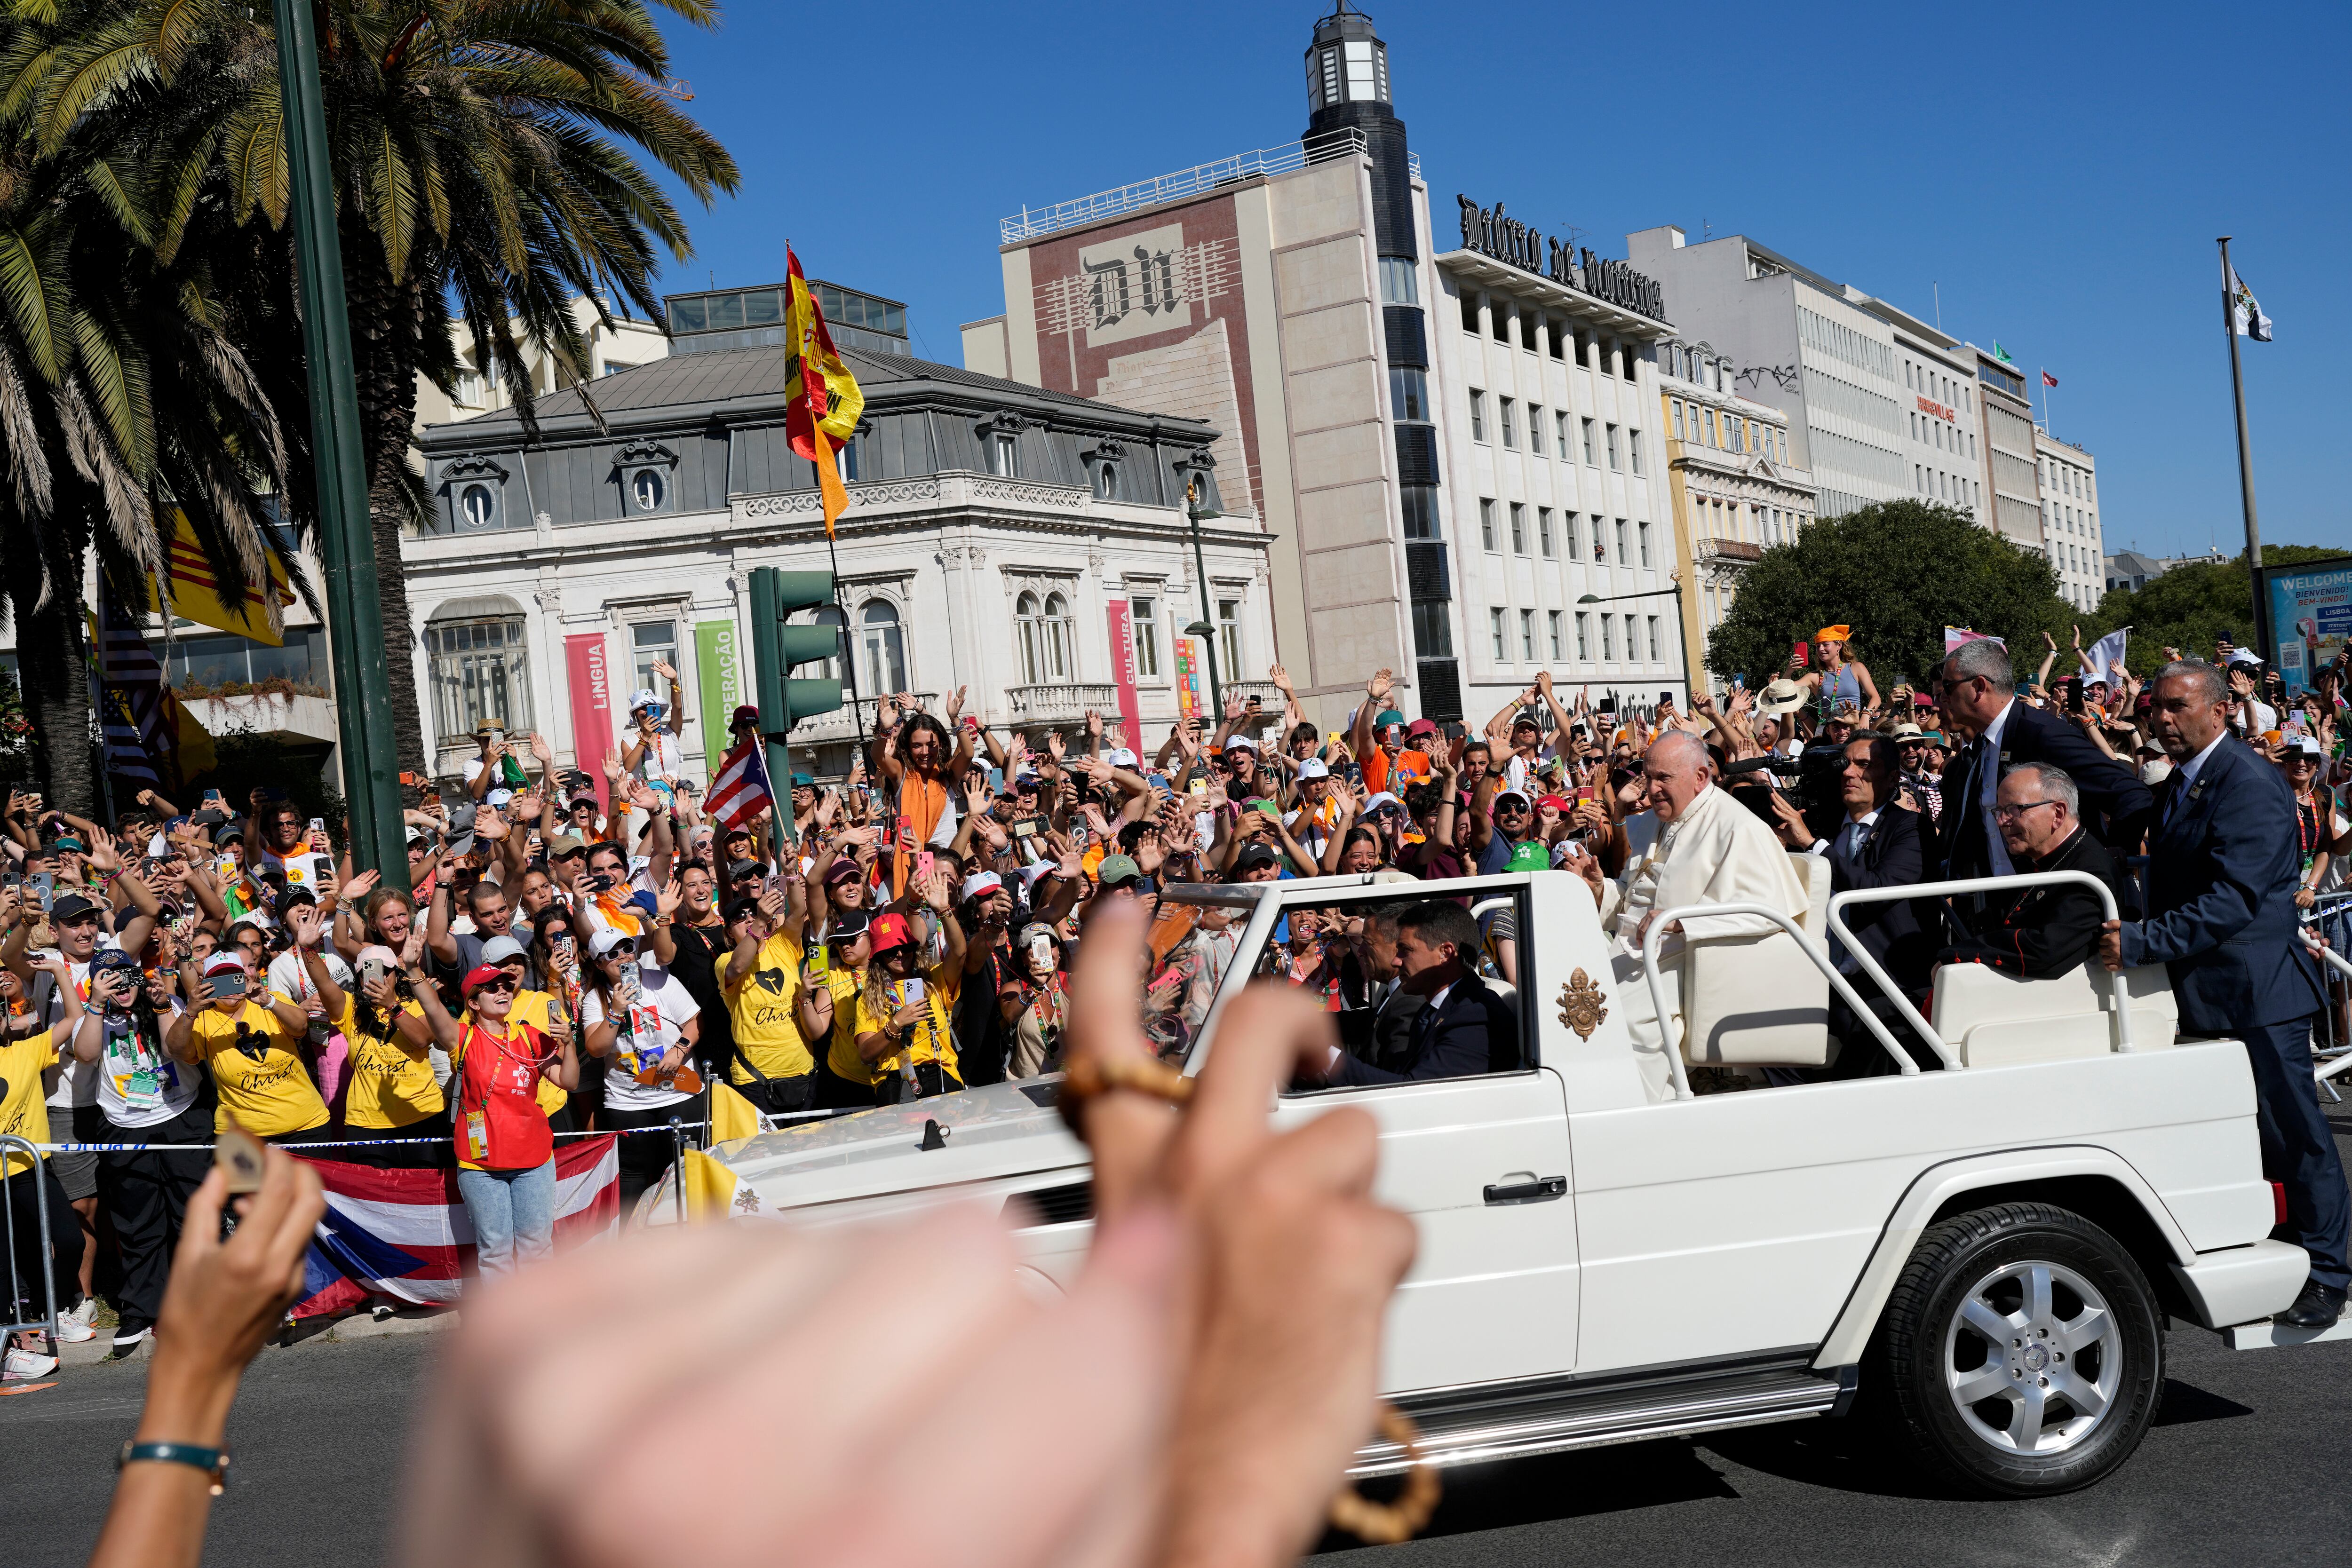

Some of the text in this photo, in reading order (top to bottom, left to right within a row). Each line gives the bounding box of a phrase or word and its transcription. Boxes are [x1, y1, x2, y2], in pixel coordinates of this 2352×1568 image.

[2281, 571, 2352, 591] WELCOME
[2296, 586, 2349, 598] BIENVENIDO!
[2298, 594, 2348, 606] BEM-VINDO!
[1121, 611, 1134, 685] CULTURA
[588, 643, 607, 709] LÍNGUA
[95, 951, 124, 966] LISBOA
[755, 1004, 799, 1025] Chris
[259, 1061, 287, 1074] THROUGH
[357, 1053, 411, 1073] Christ
[241, 1059, 295, 1091] Christ
[486, 1075, 497, 1098] CASCAIS
[1924, 1243, 2002, 1385] GEOLANDAR
[2064, 1375, 2151, 1484] YOKOHAMA
